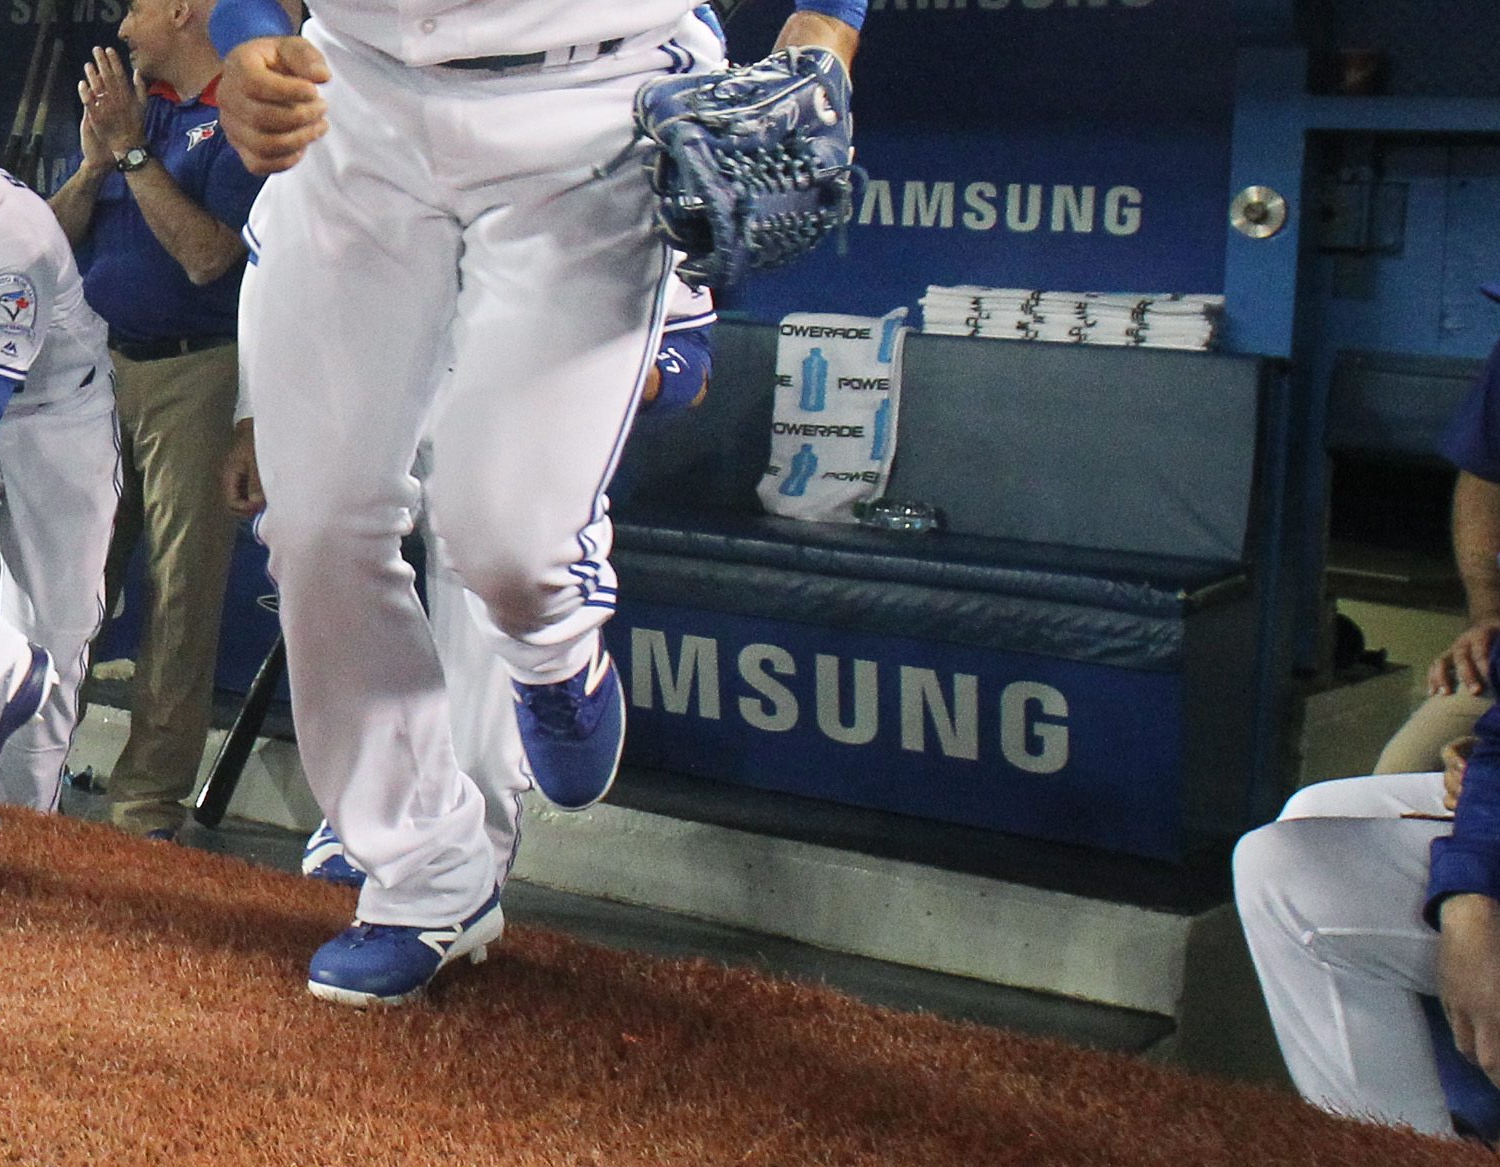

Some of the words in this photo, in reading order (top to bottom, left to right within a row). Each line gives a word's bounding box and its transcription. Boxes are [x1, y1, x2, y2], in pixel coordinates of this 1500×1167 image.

[858, 180, 1143, 236] AMSUNG
[781, 324, 873, 340] OWERADE
[838, 377, 890, 391] POWE
[773, 422, 865, 438] OWERADE
[630, 627, 1070, 774] MSUNG
